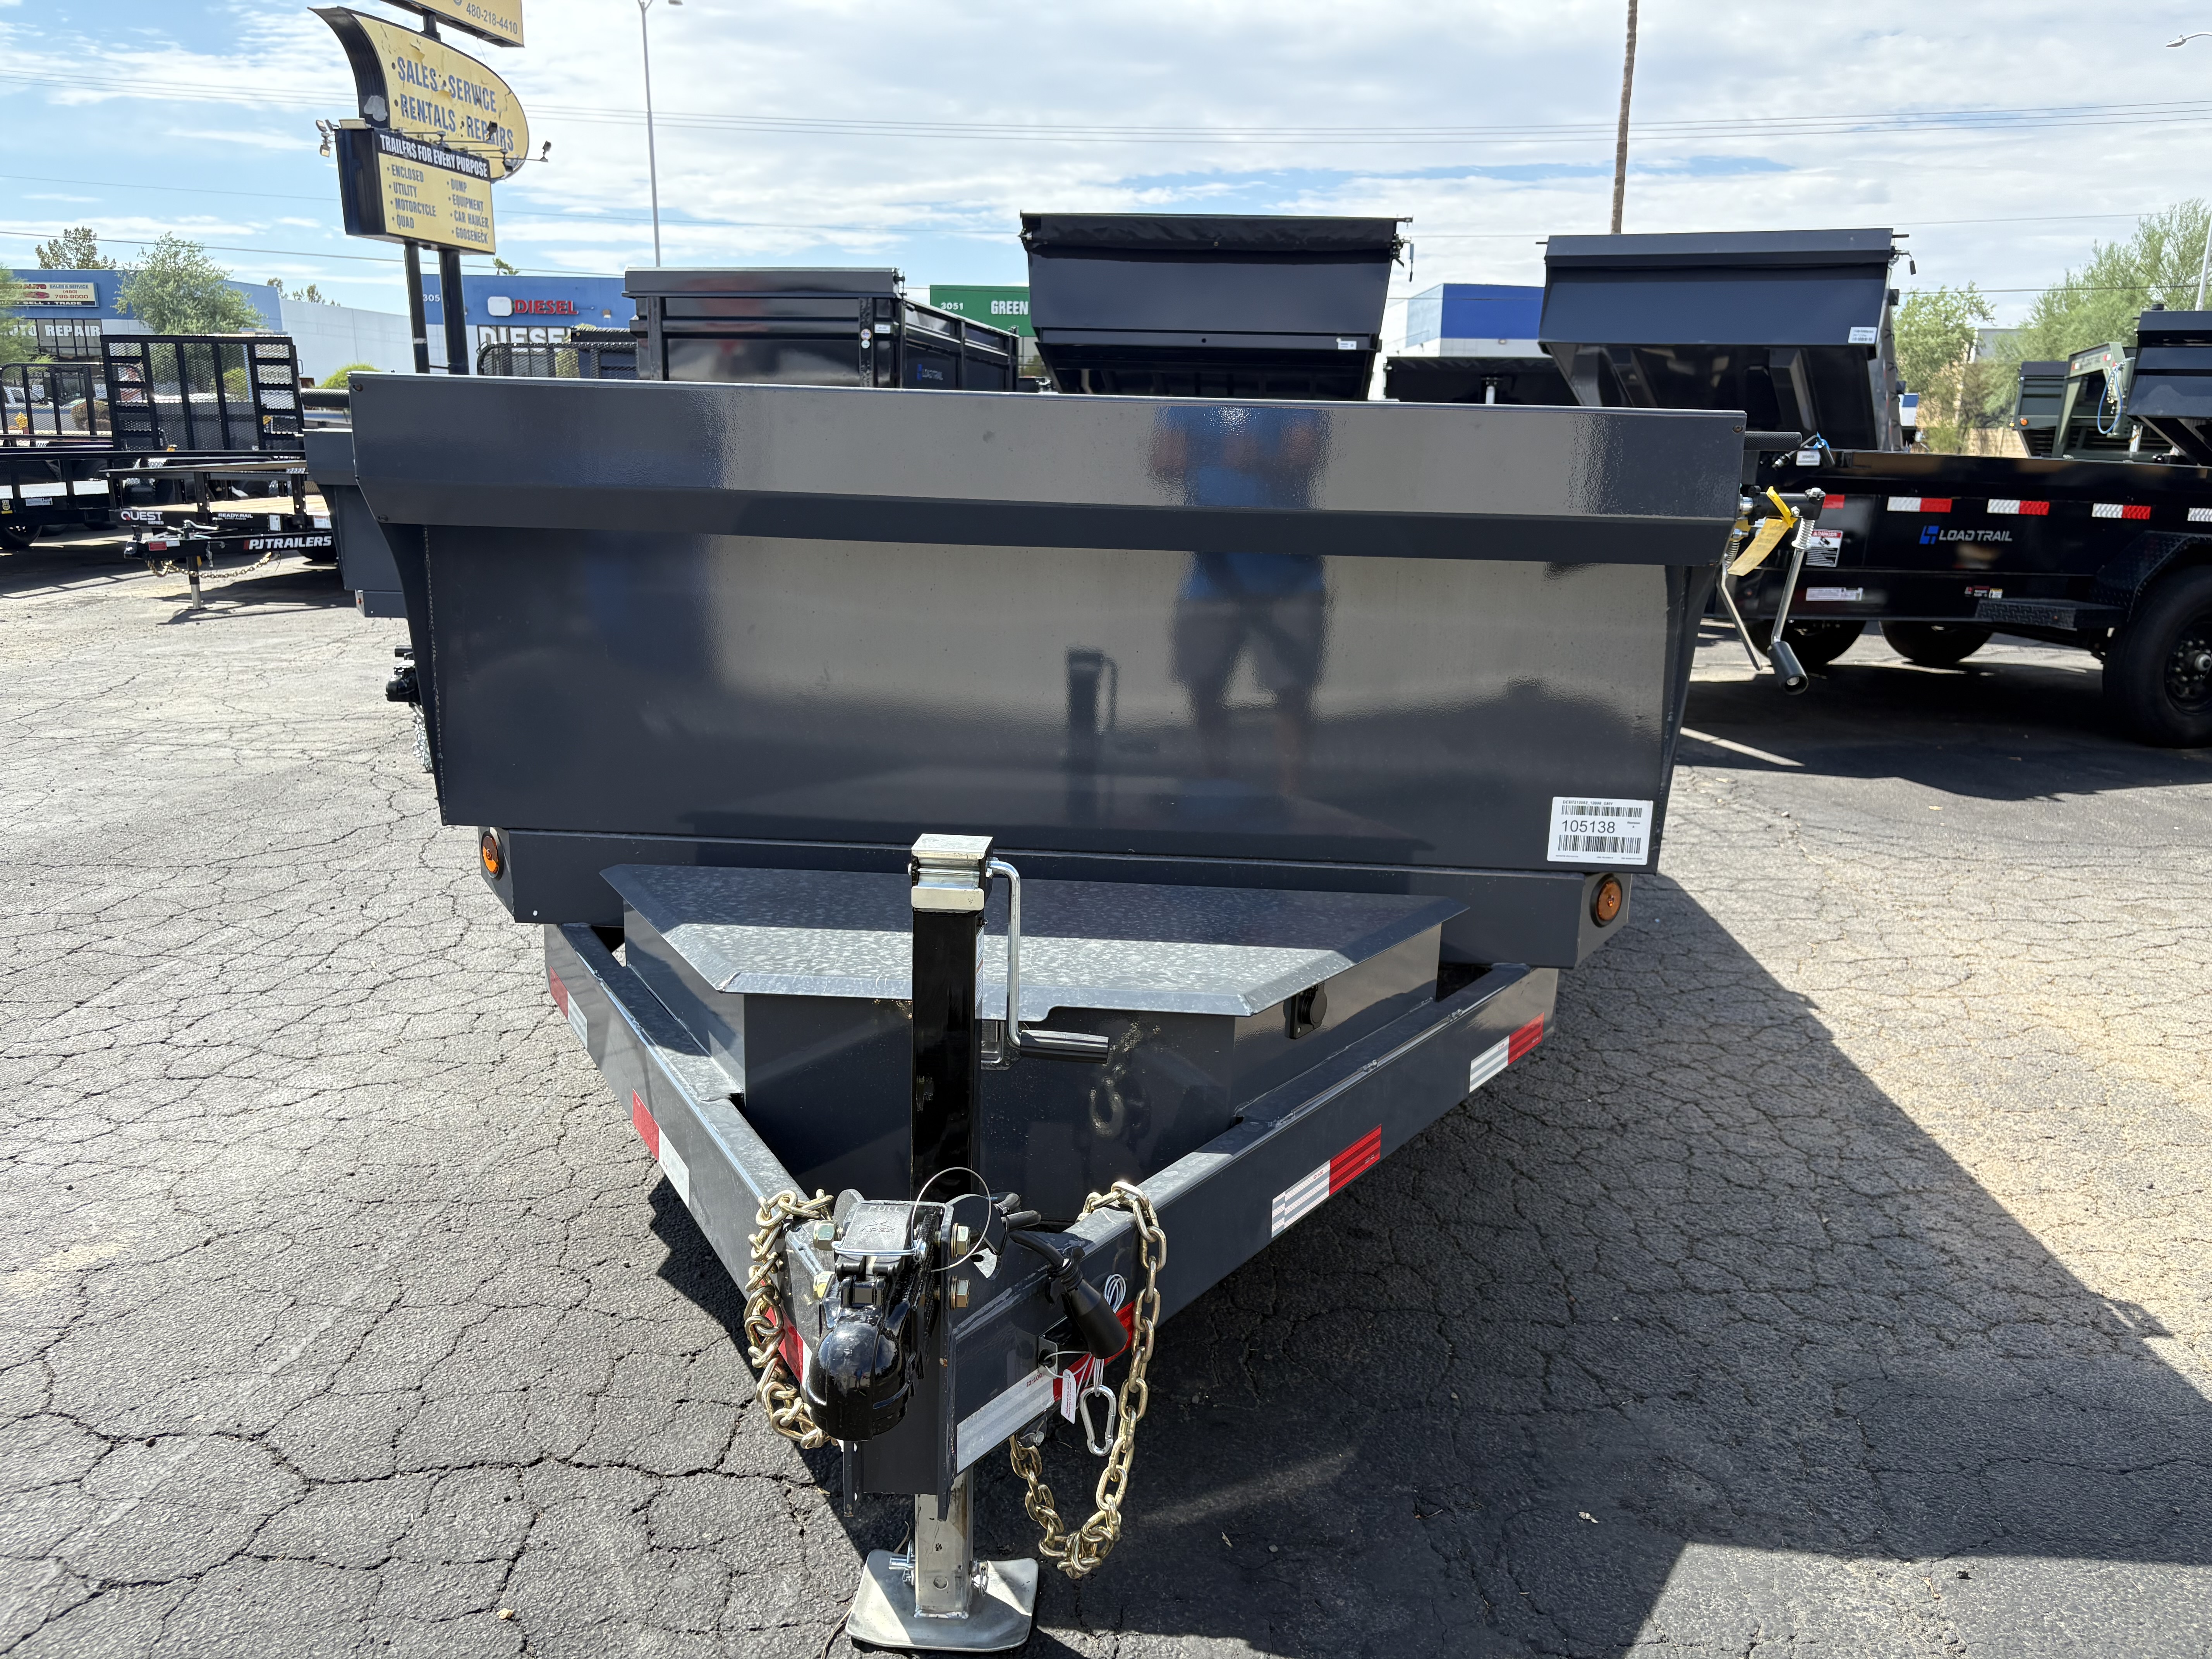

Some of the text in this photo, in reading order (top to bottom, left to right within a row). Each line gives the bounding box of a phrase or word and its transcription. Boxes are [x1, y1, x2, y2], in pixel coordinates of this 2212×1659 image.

[466, 2, 518, 34] 480-218-4410
[397, 56, 497, 113] SALES SERVICE
[400, 93, 457, 133] RENTALS
[380, 134, 488, 178] TRAILERS FOR EVERY PURPOSE
[391, 164, 424, 183] ENCLOSED
[393, 182, 417, 198] UTILITY
[451, 178, 467, 193] DUMP
[395, 198, 437, 217] MOTORCYCLE
[452, 194, 484, 212] EQUIPMENT
[397, 215, 415, 230] QUAD
[454, 210, 489, 230] CAR HAULER
[455, 227, 489, 245] GOOSENECK
[514, 299, 579, 315] DIESEL
[991, 301, 1029, 315] GREEN
[45, 325, 101, 337] REPAIR
[478, 326, 572, 352] DIESE
[121, 511, 163, 520] QUEST
[249, 536, 332, 550] PJ TRAILERS
[1939, 529, 2013, 542] LOAD TRAIL
[1562, 820, 1615, 833] 105138
